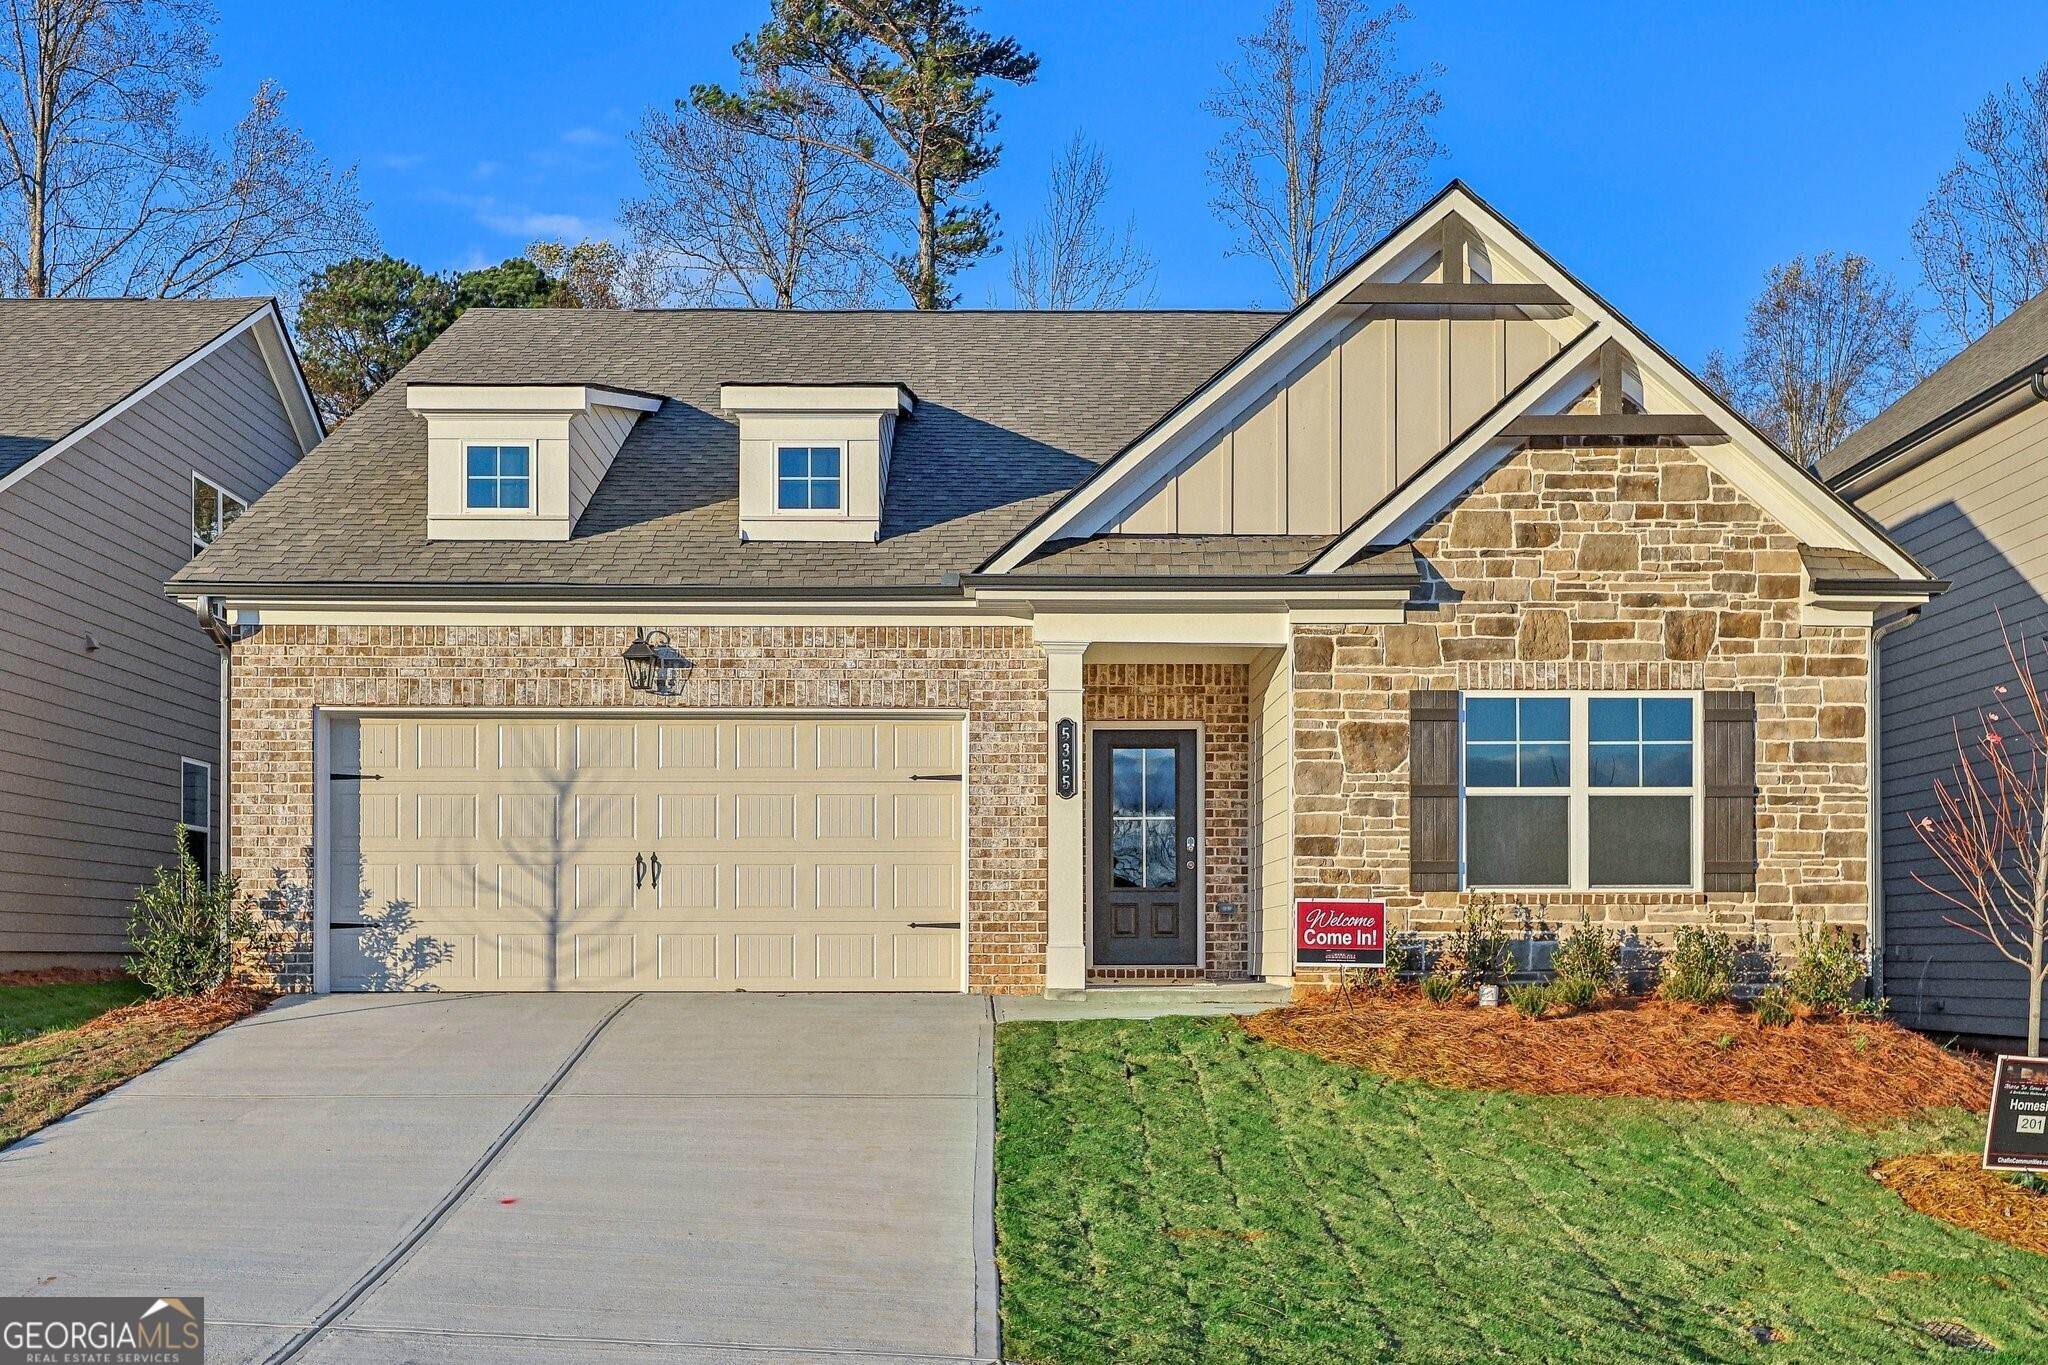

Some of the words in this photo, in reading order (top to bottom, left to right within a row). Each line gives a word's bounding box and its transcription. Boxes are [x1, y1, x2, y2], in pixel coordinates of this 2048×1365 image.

[1062, 727, 1071, 789] 5355
[1306, 908, 1376, 928] Welcome
[1304, 928, 1352, 945] Come
[1357, 929, 1377, 946] In!
[2021, 1118, 2042, 1130] 201
